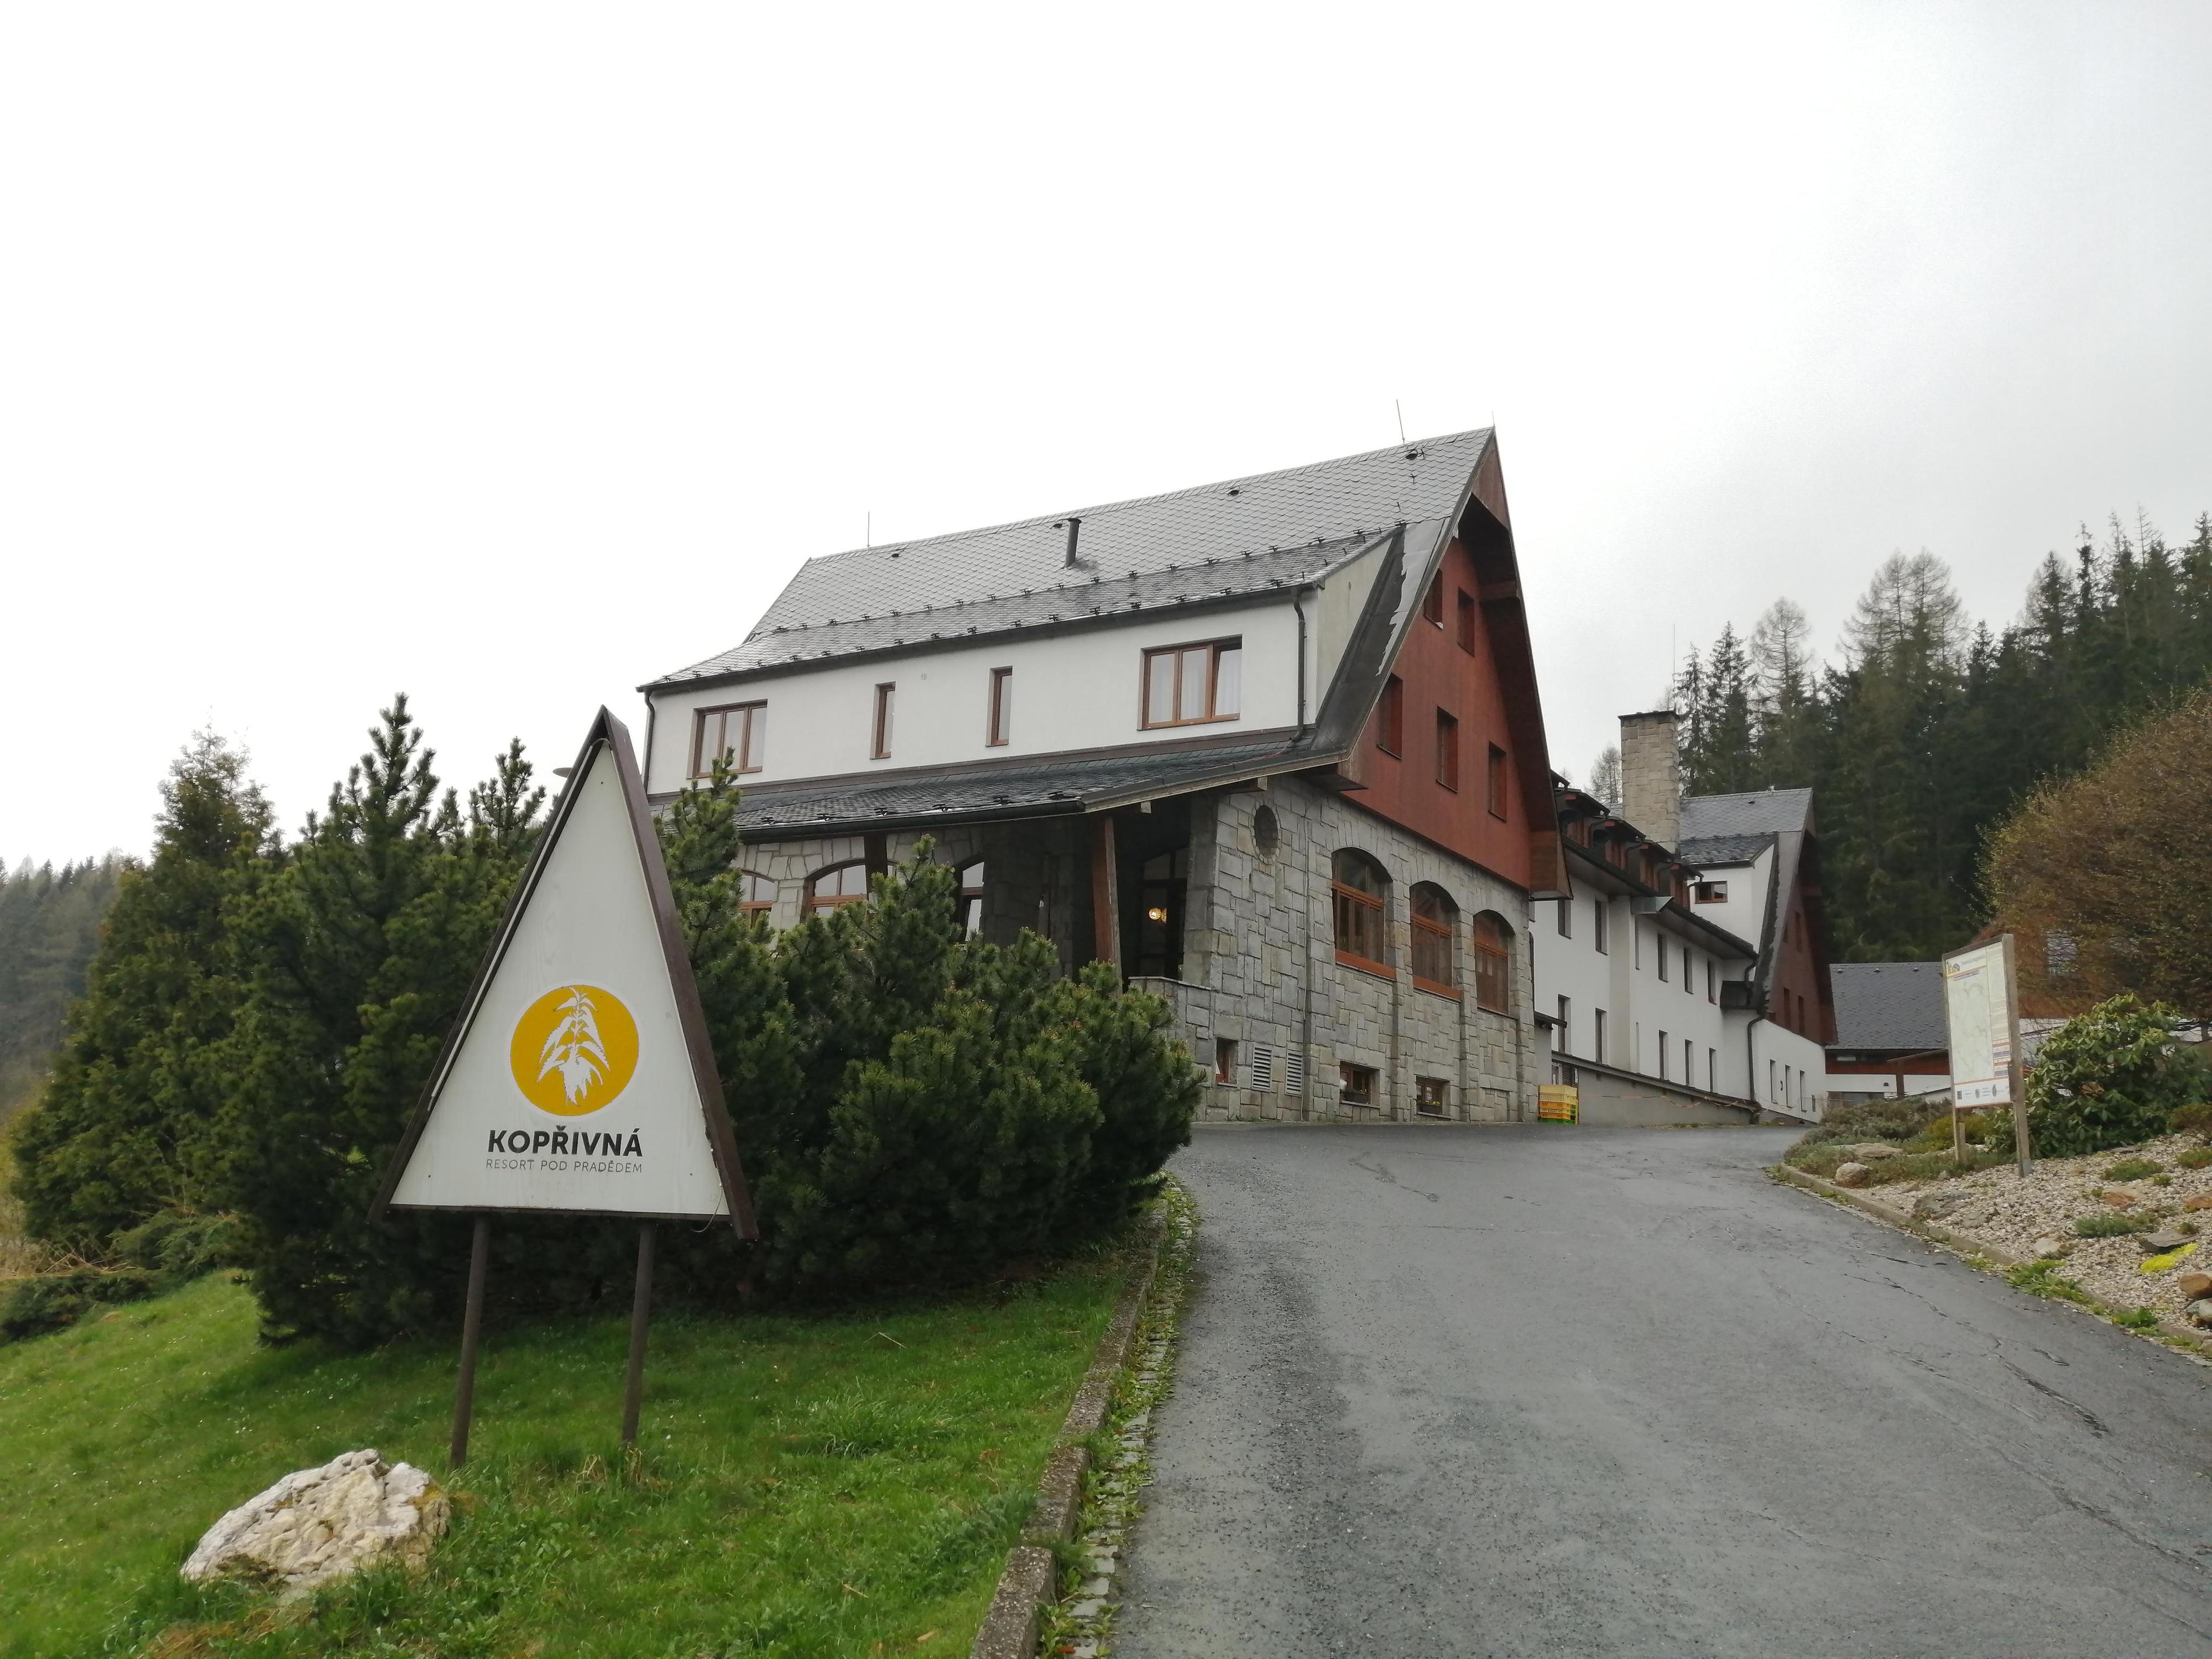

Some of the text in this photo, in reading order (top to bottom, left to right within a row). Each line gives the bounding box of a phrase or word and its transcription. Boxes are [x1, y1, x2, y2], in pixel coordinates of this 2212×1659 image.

[488, 1125, 643, 1157] KOPŘIVNÁ
[486, 1159, 534, 1170] RESORT
[540, 1160, 567, 1171] POD
